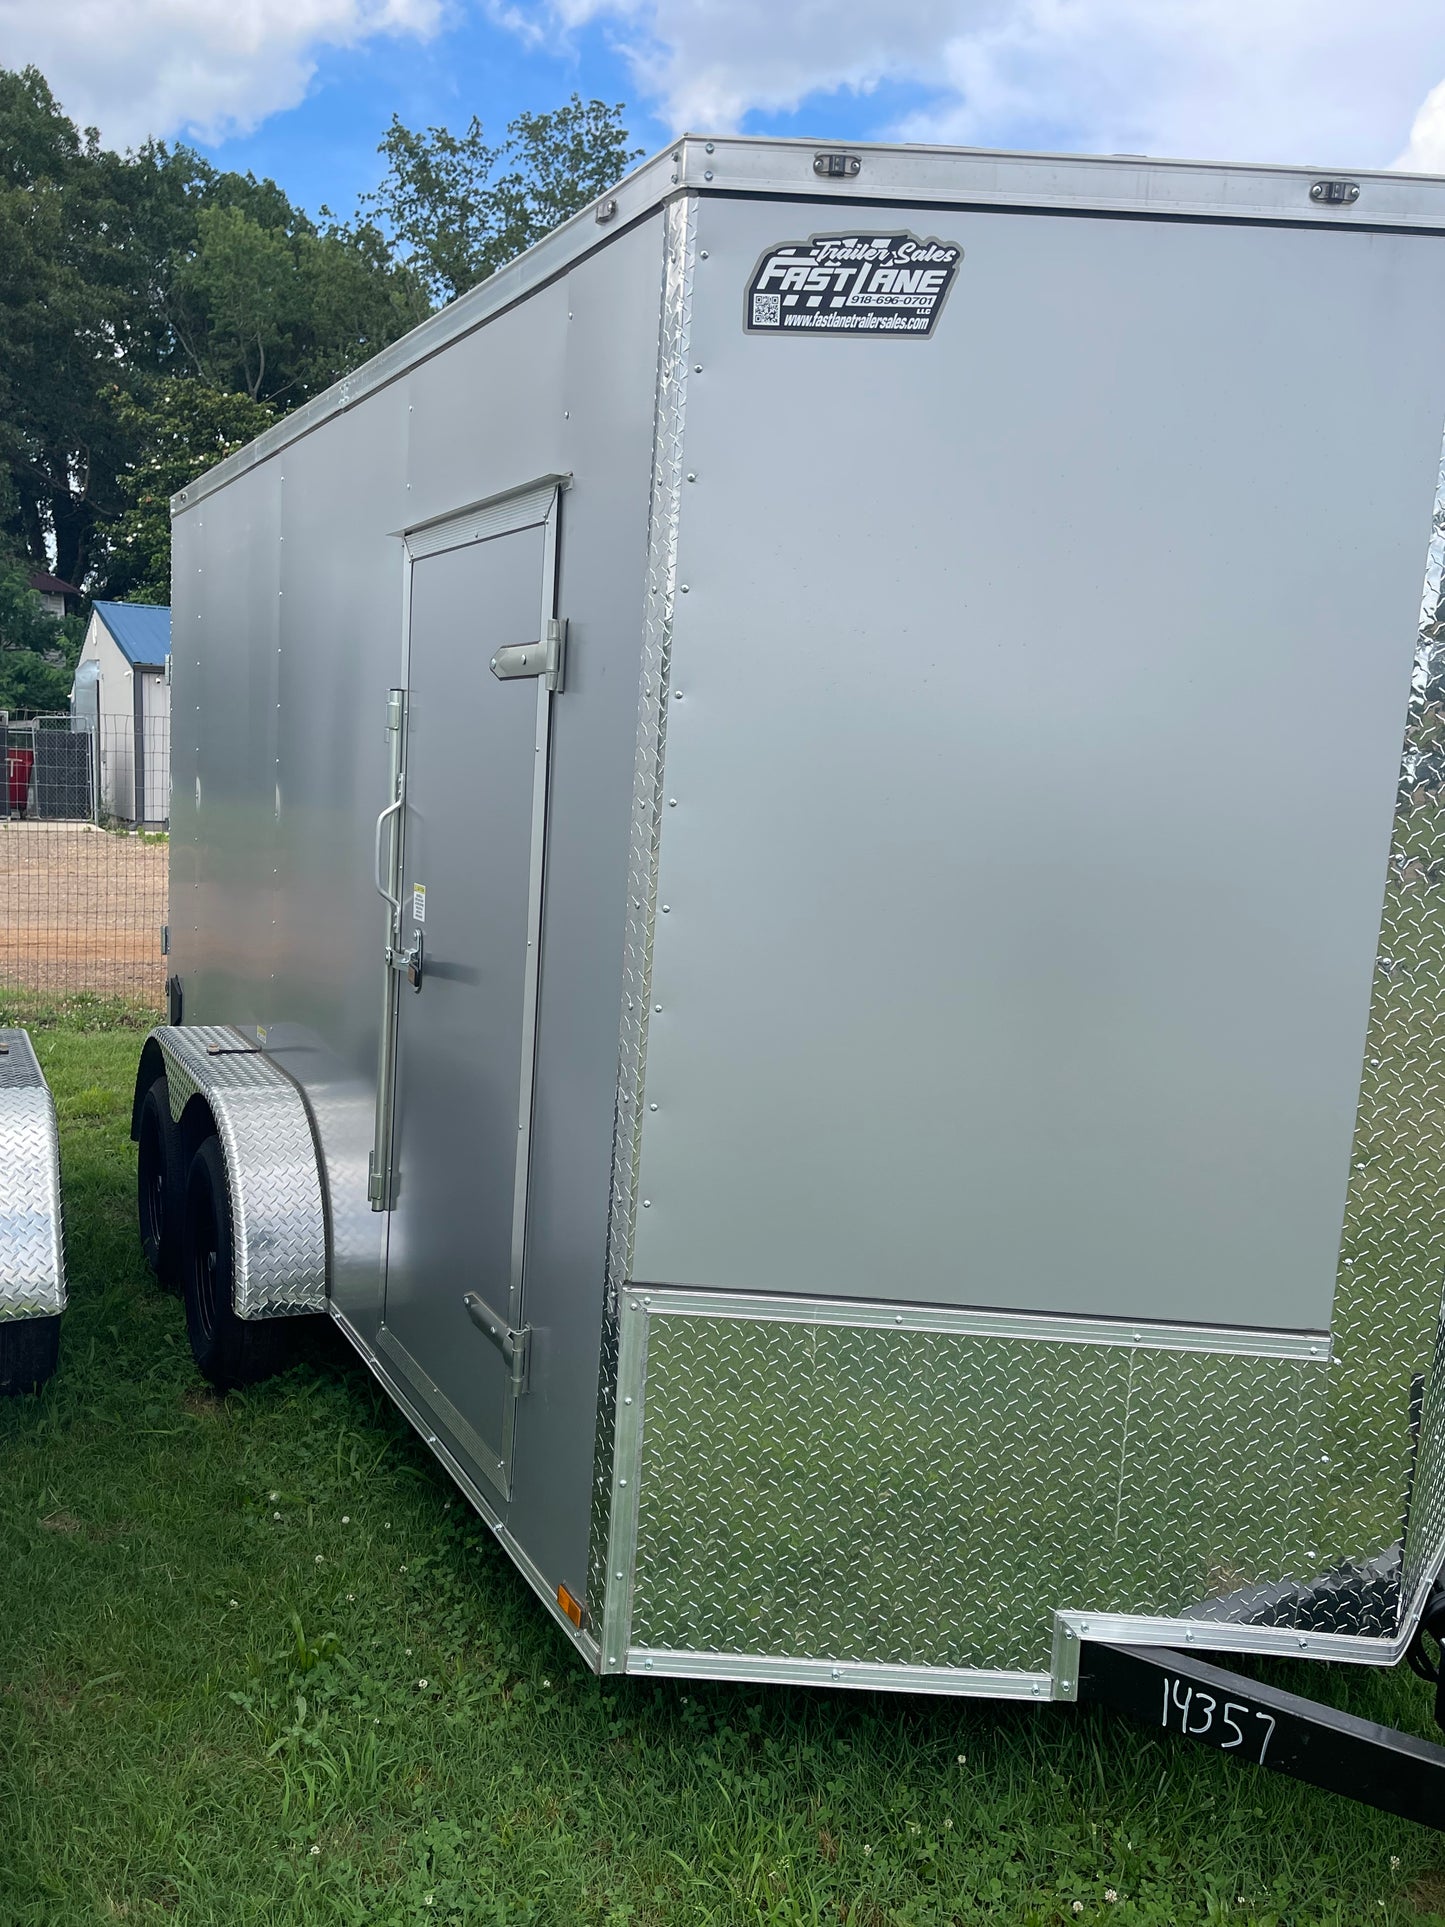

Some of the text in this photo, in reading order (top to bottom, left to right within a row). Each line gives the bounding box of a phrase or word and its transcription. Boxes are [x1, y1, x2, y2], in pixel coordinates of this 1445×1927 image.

[816, 240, 957, 264] Trailer Sales
[756, 256, 858, 292] FAST
[851, 295, 934, 306] 918-696-0701
[783, 311, 930, 330] www.fastlanetrailersales.com
[1162, 1678, 1276, 1766] 14357
